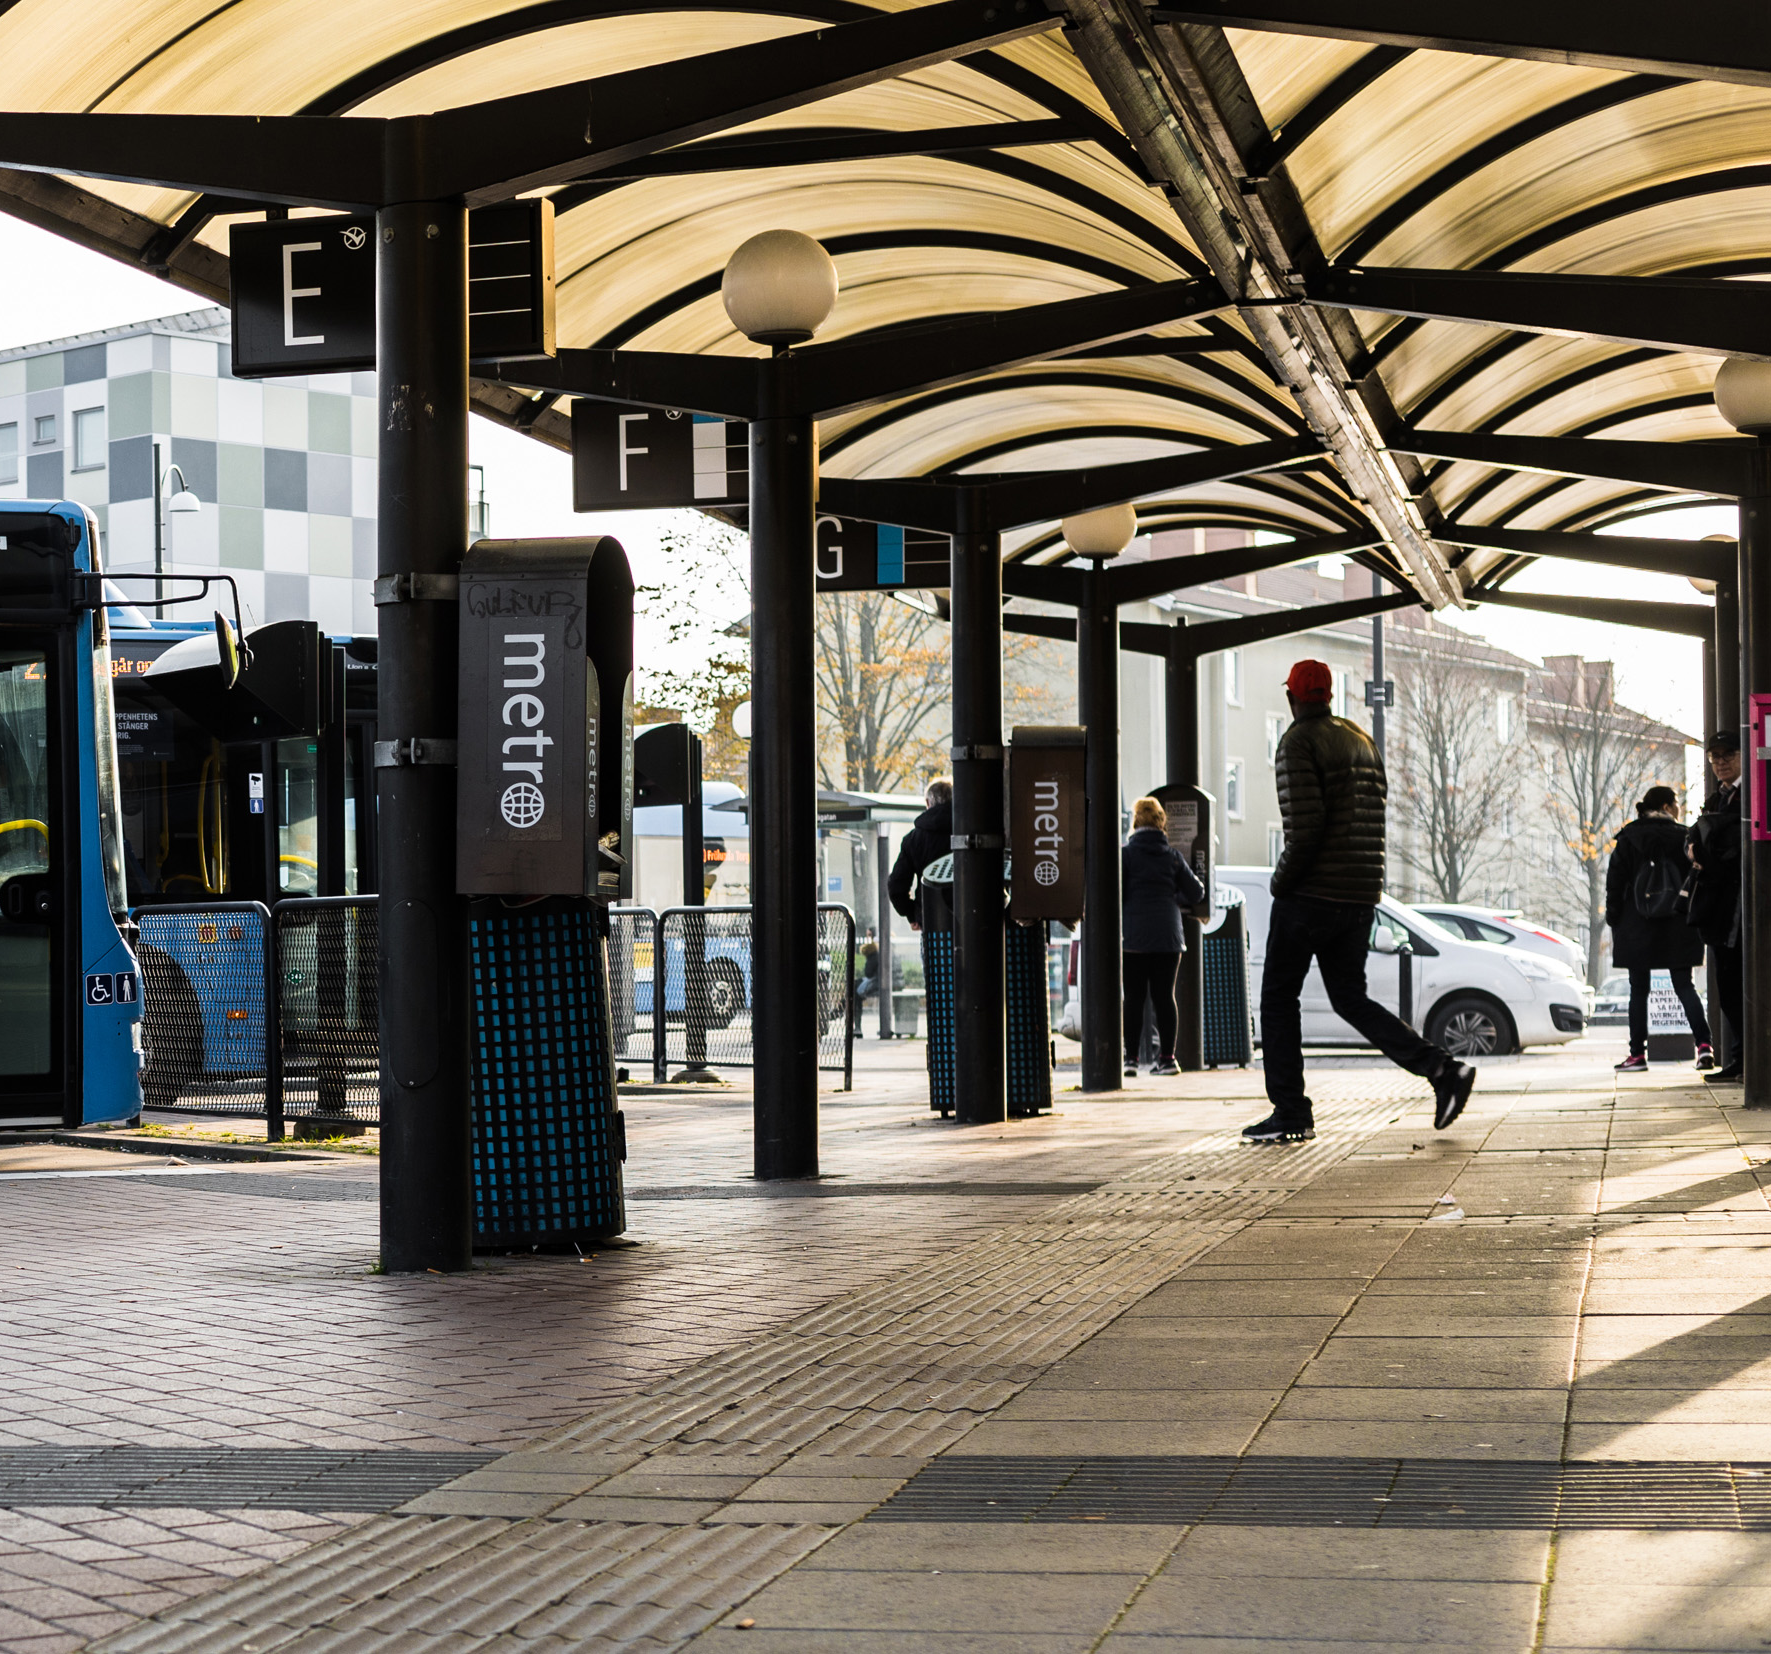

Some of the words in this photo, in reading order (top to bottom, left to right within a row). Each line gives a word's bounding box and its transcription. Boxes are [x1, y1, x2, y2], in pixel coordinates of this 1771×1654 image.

[283, 242, 325, 346] E
[619, 413, 649, 491] F
[815, 516, 843, 579] G
[111, 657, 134, 678] går
[115, 713, 158, 721] PPENHETENS
[116, 732, 131, 740] RIG.
[501, 634, 554, 828] metro
[588, 717, 598, 818] metro
[624, 723, 634, 821] metro
[818, 813, 837, 823] gatan
[1034, 782, 1065, 886] metro
